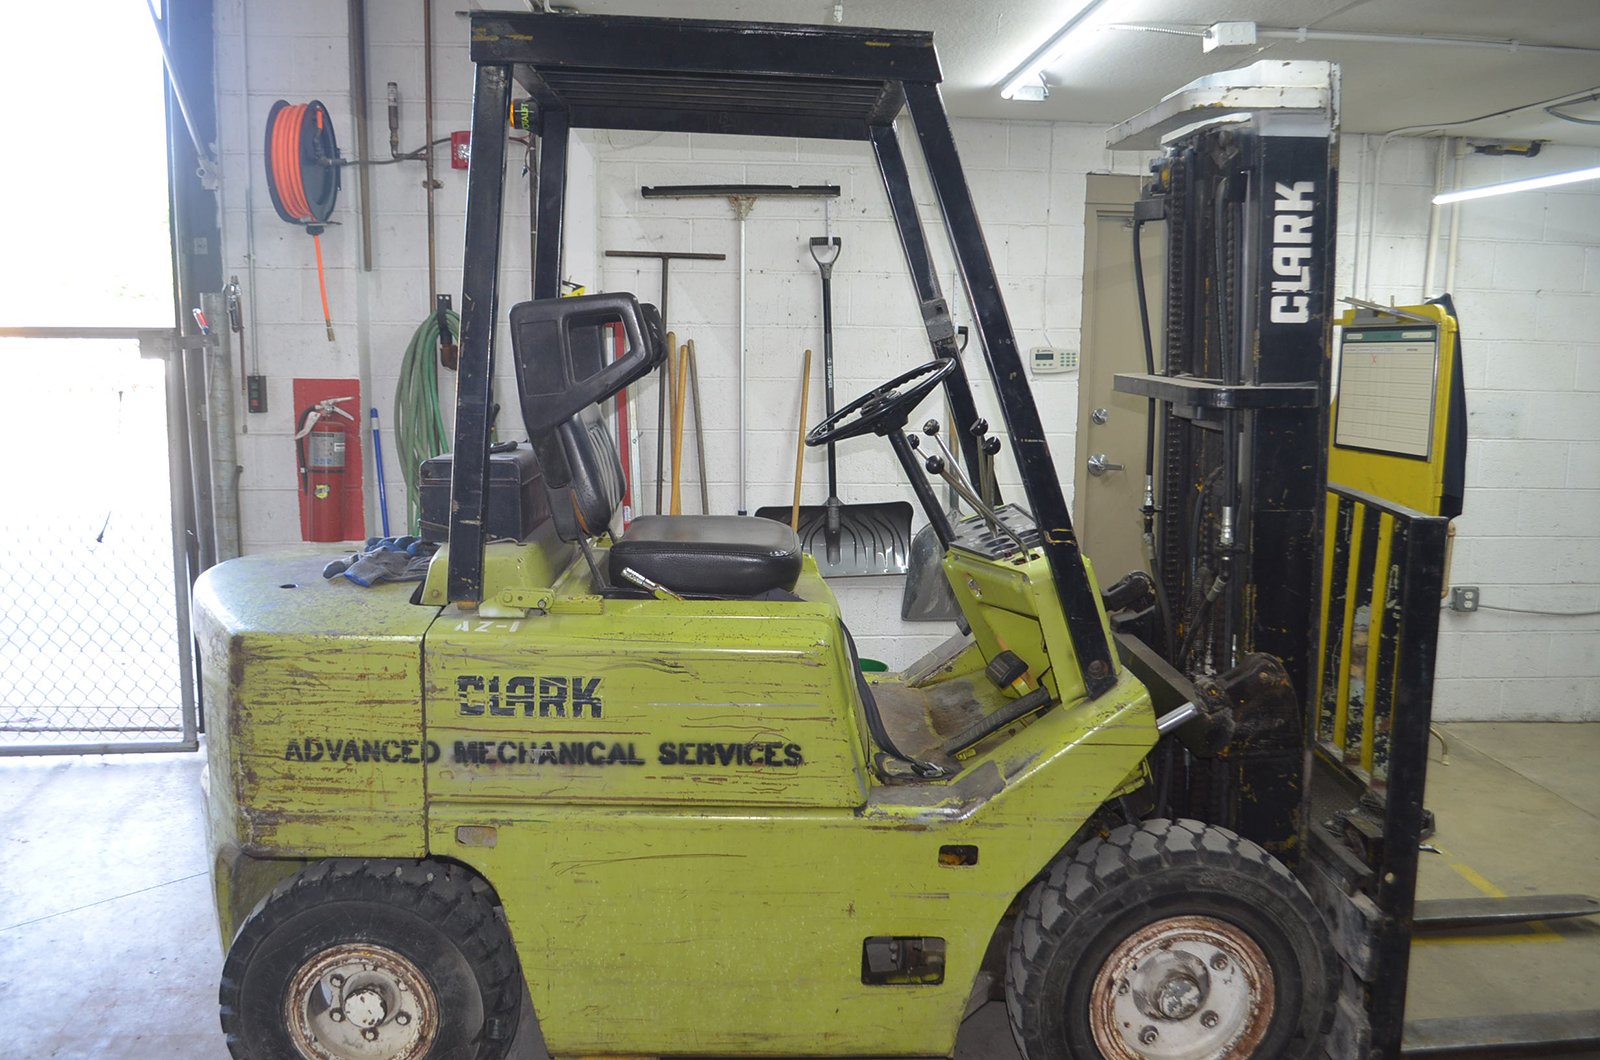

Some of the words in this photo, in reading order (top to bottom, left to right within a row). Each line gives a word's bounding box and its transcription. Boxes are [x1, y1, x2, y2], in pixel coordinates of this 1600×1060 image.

[1270, 181, 1314, 323] CLARK
[457, 675, 602, 718] CLARK
[284, 737, 441, 764] ADVANCED
[453, 740, 646, 766] MECHANICAL
[658, 741, 803, 767] SERVICES
